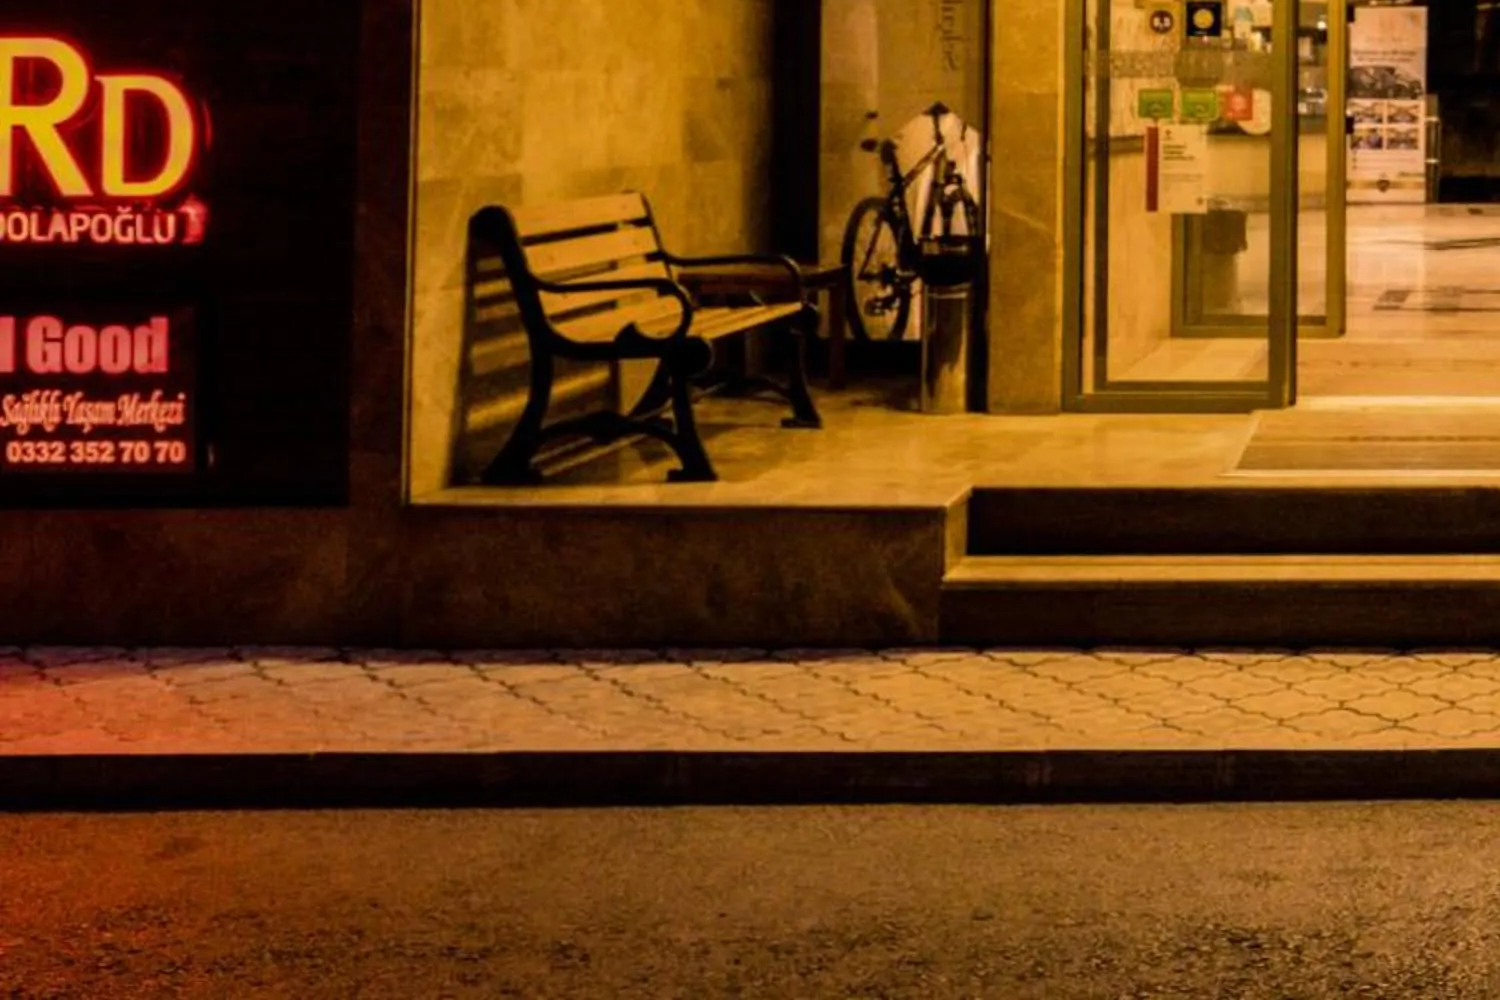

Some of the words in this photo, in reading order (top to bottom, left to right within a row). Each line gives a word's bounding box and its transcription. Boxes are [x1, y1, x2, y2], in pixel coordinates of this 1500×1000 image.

[0, 206, 176, 243] OLAPOĞLU
[26, 316, 169, 374] Good
[6, 441, 66, 463] 0332
[70, 441, 115, 463] 352
[118, 441, 150, 463] 70
[154, 441, 186, 463] 70
